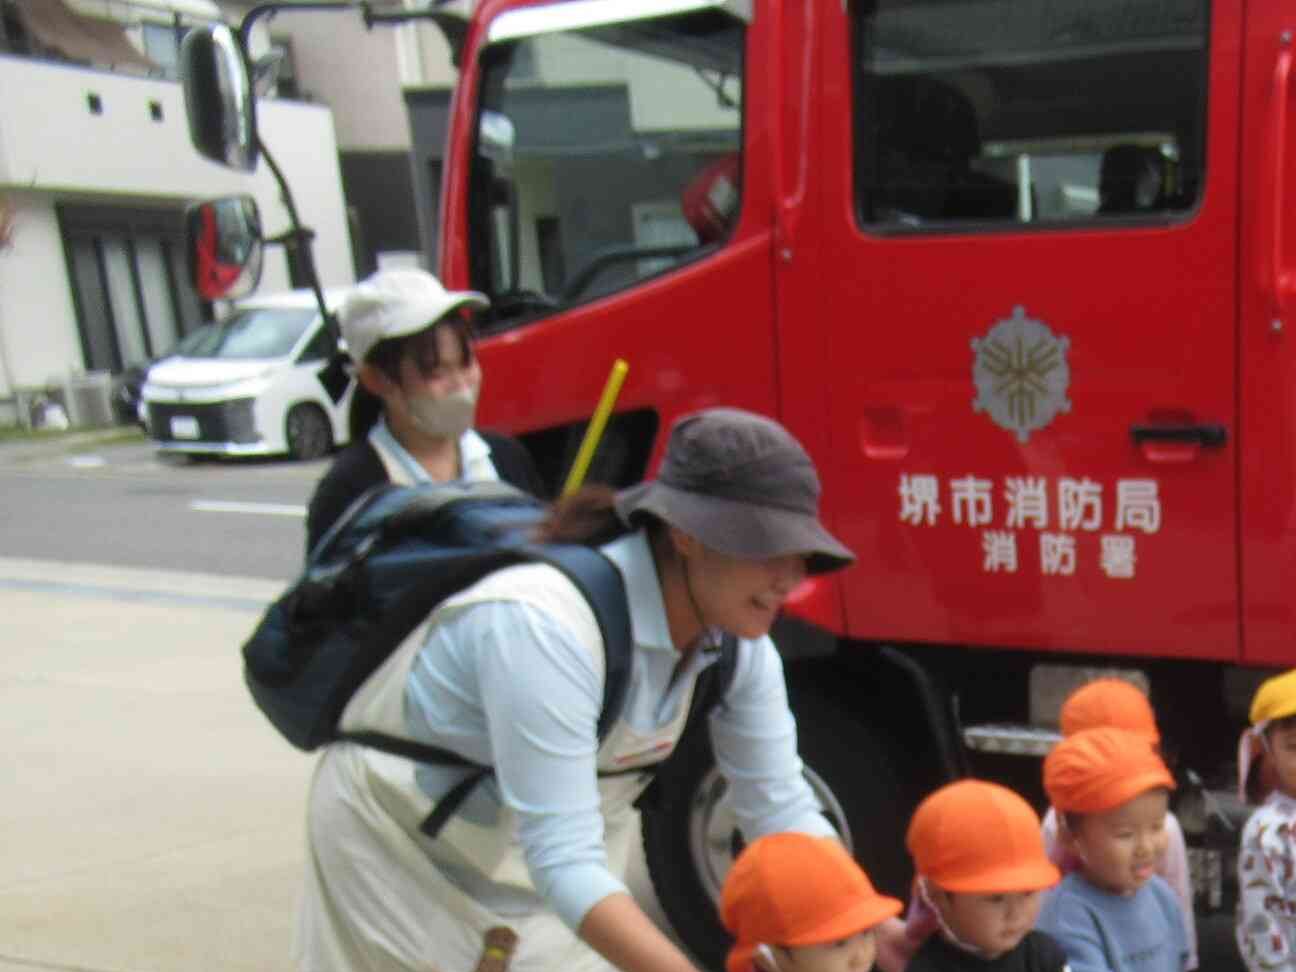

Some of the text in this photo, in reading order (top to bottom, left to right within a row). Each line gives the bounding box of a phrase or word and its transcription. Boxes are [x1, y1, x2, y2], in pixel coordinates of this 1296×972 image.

[899, 473, 1161, 532] 堺市消防局
